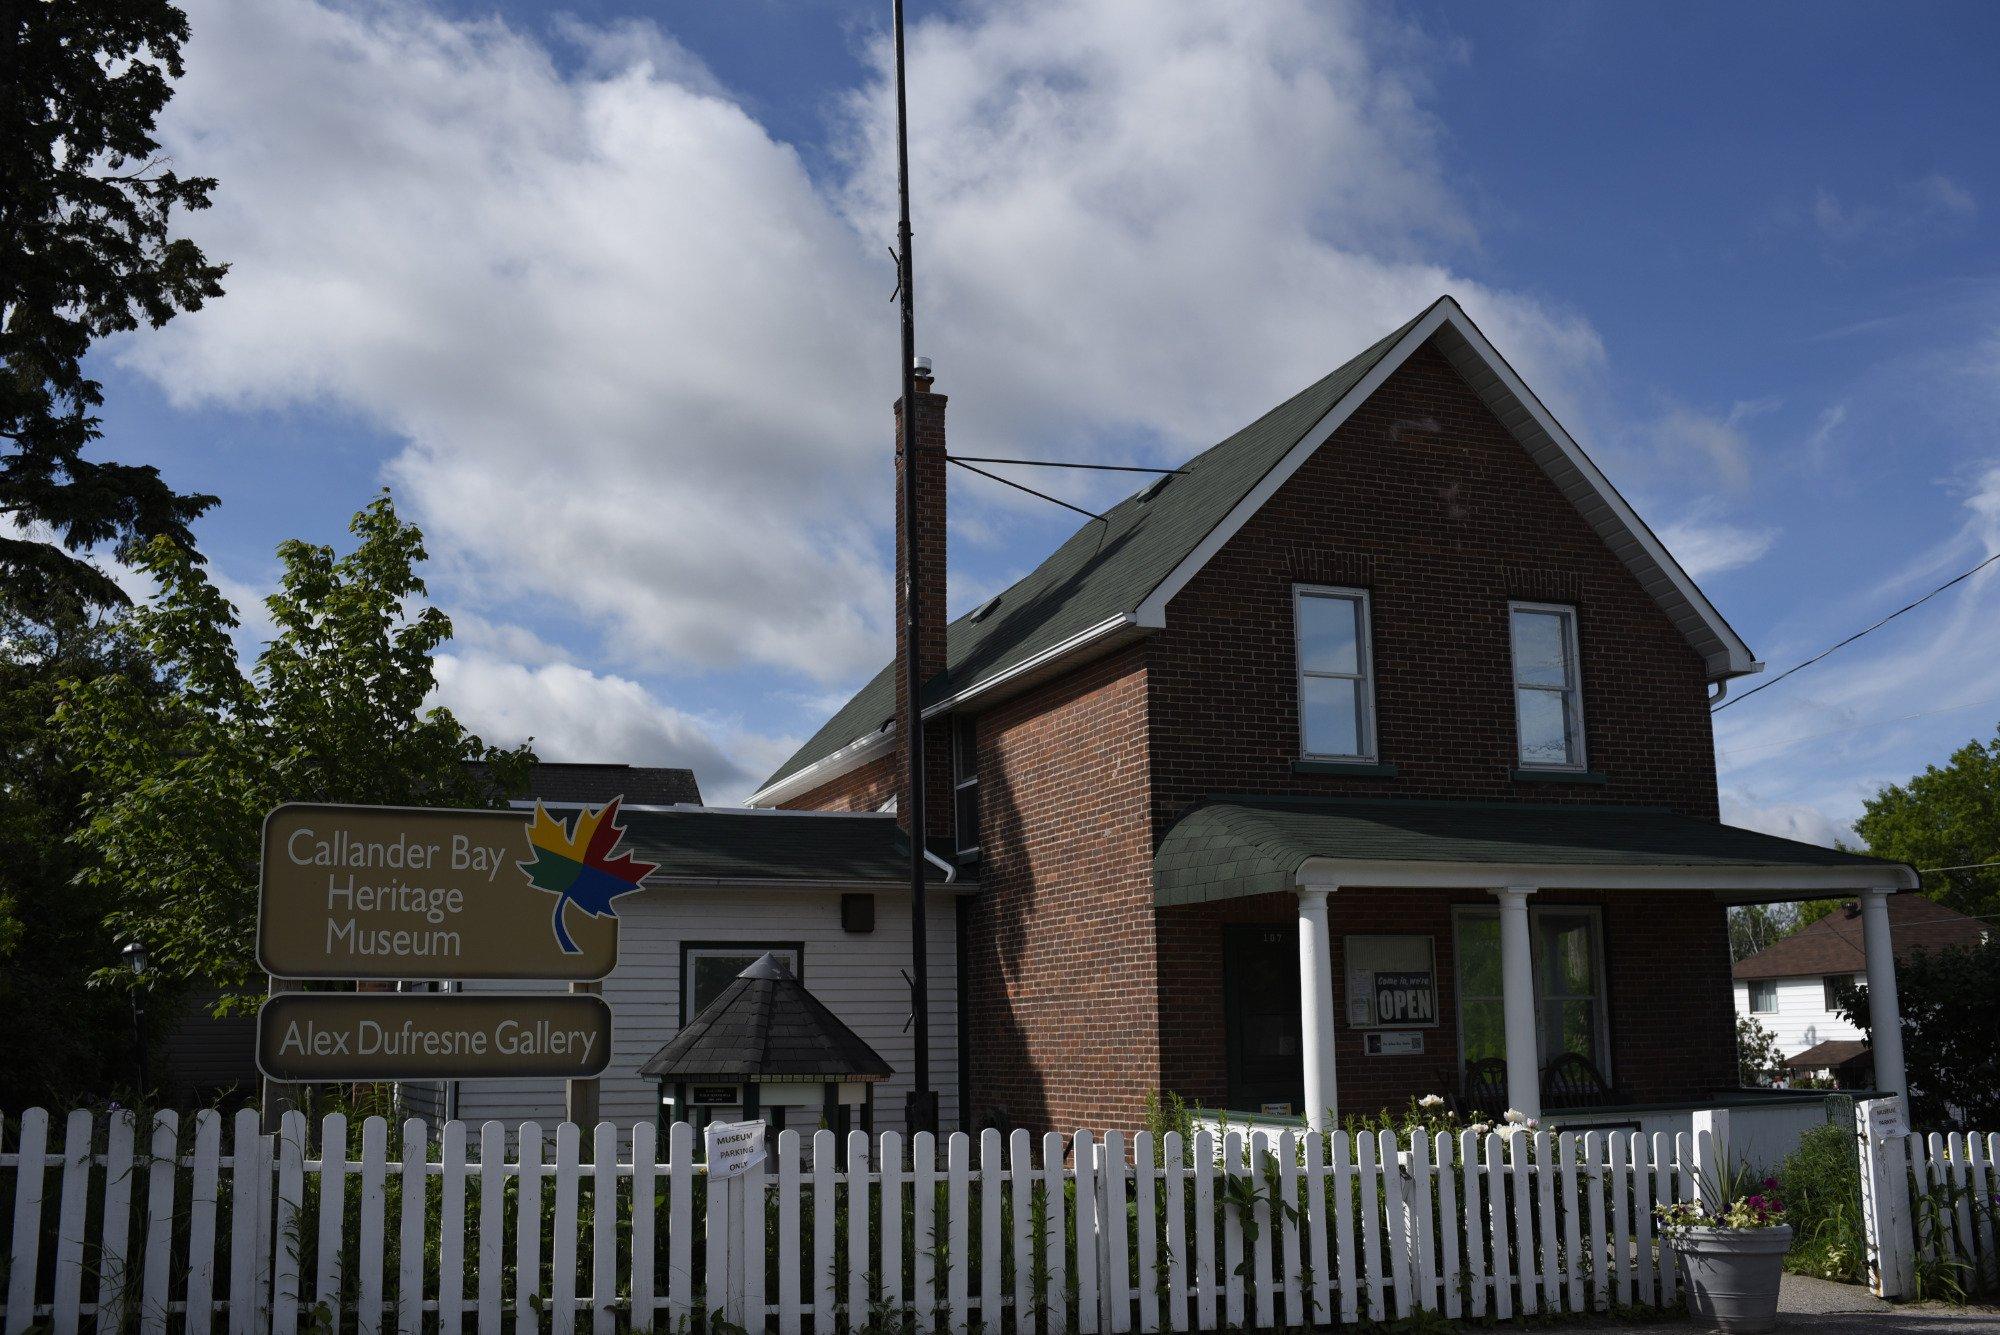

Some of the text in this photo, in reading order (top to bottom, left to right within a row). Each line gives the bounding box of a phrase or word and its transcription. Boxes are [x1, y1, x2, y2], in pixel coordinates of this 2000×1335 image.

[287, 828, 506, 882] Callander Bay
[327, 873, 464, 924] Heritage
[325, 917, 461, 956] Museum
[1378, 976, 1398, 986] Come
[1379, 989, 1432, 1020] OPEN
[278, 1019, 597, 1065] Alex Dufresne Gallery
[717, 1133, 753, 1145] MUSEUM
[720, 1145, 754, 1159] PARKING
[730, 1161, 748, 1171] ONLY
